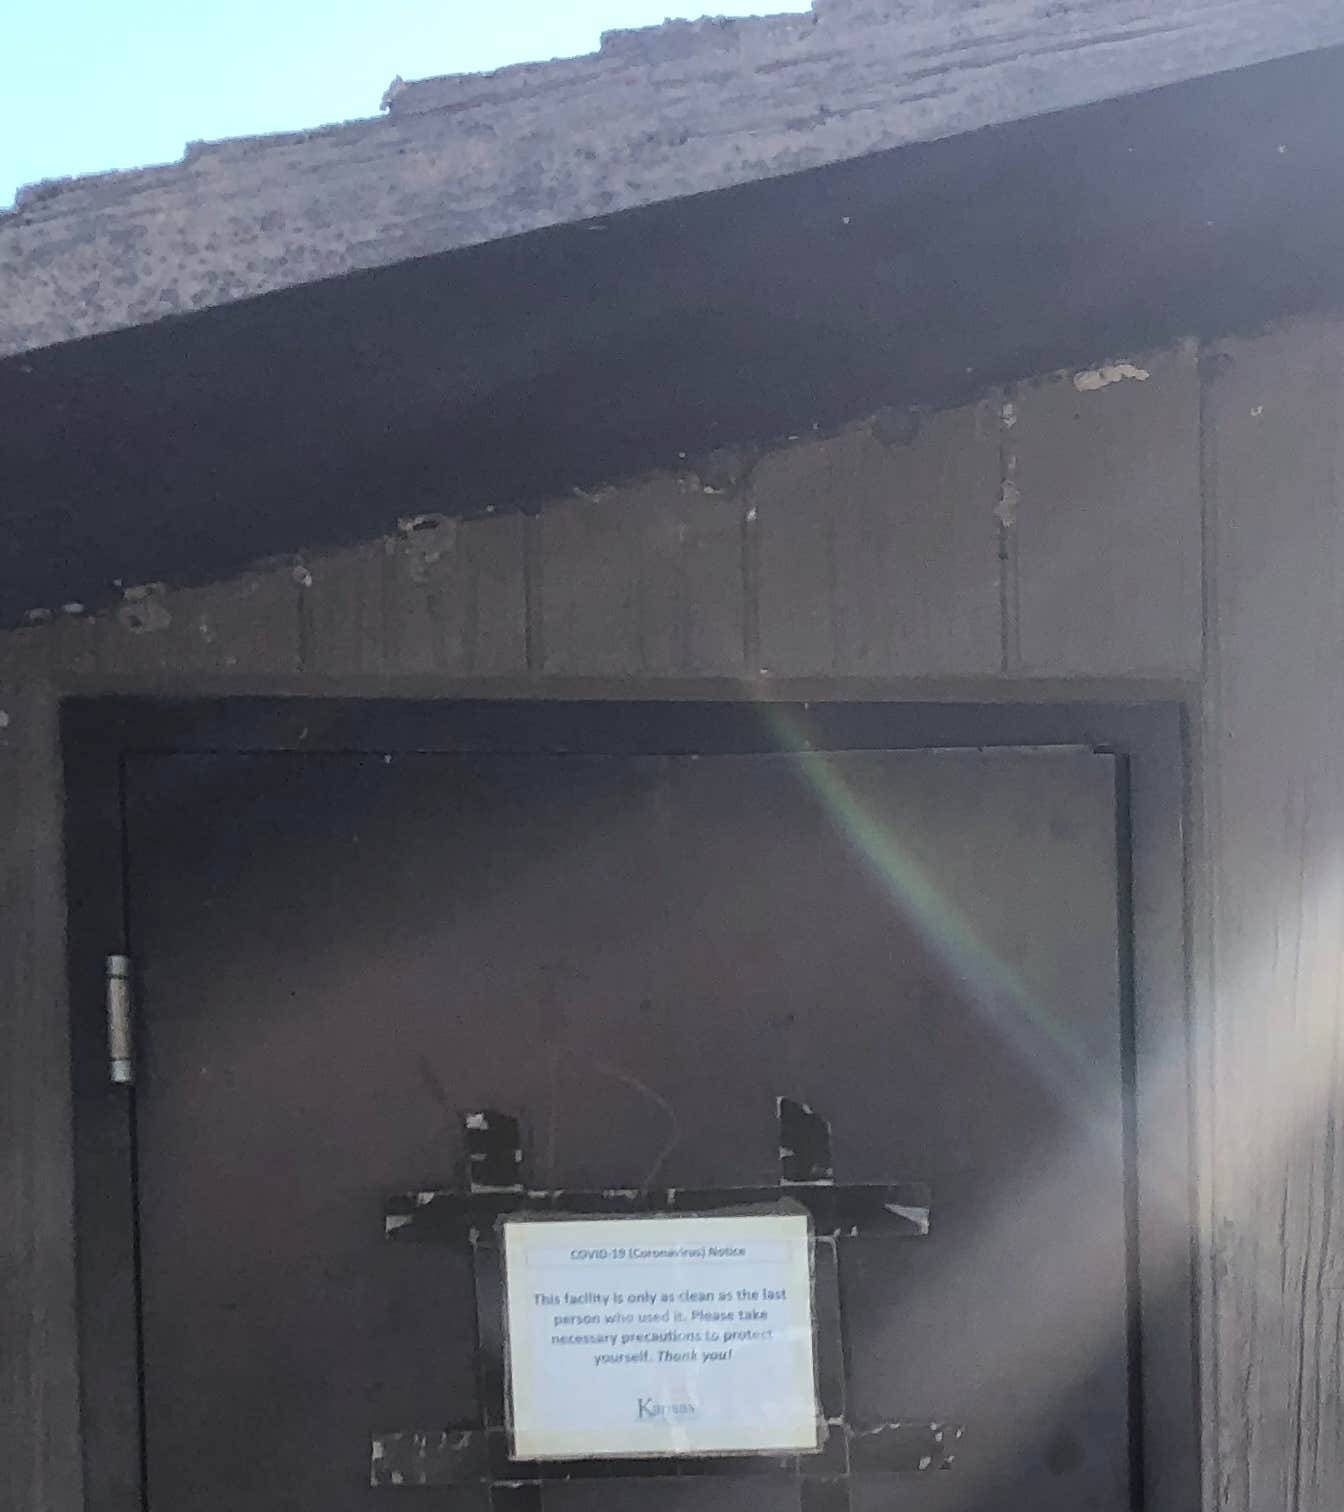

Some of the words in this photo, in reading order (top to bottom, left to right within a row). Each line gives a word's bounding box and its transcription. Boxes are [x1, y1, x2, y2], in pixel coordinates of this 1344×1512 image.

[570, 1249, 625, 1260] COVID-19
[708, 1247, 746, 1257] Notice
[535, 1293, 560, 1305] This
[565, 1292, 608, 1306] facility
[613, 1293, 623, 1304] is
[627, 1292, 657, 1305] only
[661, 1293, 674, 1302] as
[679, 1291, 714, 1301] clean
[718, 1292, 732, 1301] as
[736, 1289, 759, 1300] the
[762, 1288, 787, 1300] last
[554, 1314, 600, 1326] person
[606, 1312, 633, 1324] who
[638, 1311, 669, 1322] used
[691, 1310, 733, 1321] Please
[739, 1310, 768, 1320] take
[551, 1334, 617, 1346] necessary
[621, 1331, 699, 1345] precautions
[705, 1330, 719, 1340] to
[724, 1329, 772, 1342] protect
[658, 1350, 697, 1362] Thank
[703, 1349, 733, 1363] you!
